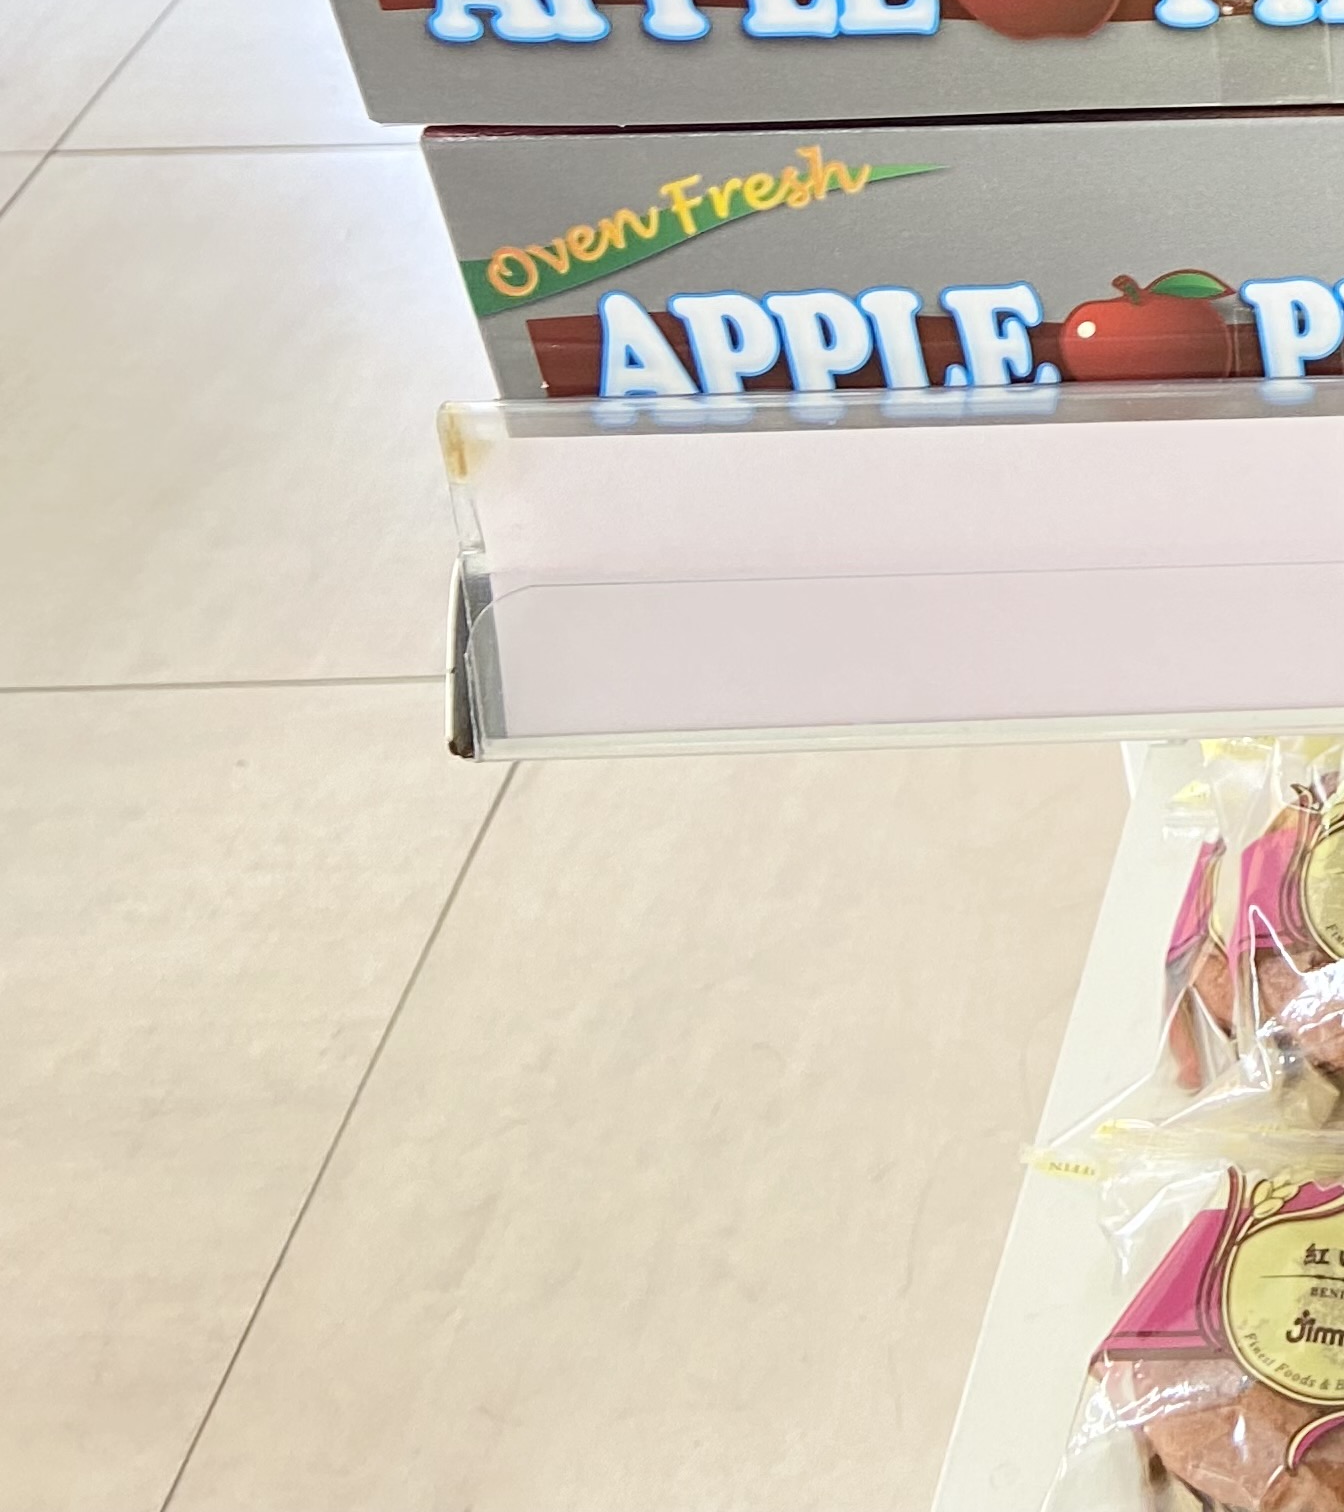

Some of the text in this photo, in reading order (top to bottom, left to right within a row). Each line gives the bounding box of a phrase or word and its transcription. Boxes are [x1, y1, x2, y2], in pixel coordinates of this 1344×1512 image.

[486, 145, 872, 297] Oven Fresh
[599, 280, 1061, 397] APPLE
